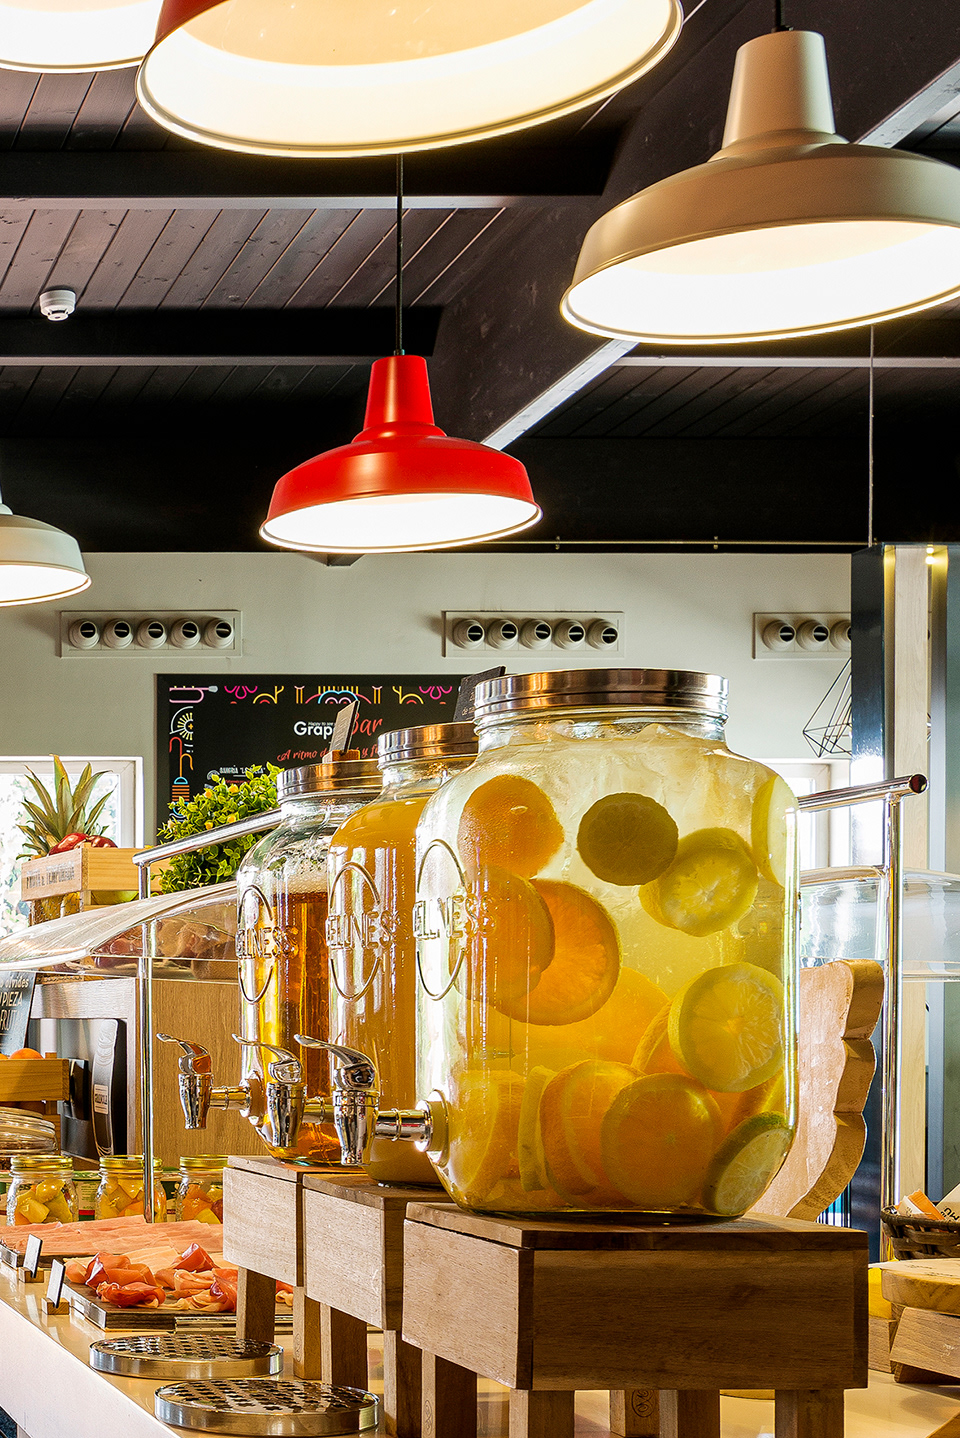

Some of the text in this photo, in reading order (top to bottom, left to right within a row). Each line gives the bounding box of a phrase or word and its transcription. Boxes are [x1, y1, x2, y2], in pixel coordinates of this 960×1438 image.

[293, 720, 334, 740] Grap
[293, 749, 318, 761] ritmo
[2, 991, 23, 1007] PIEZA
